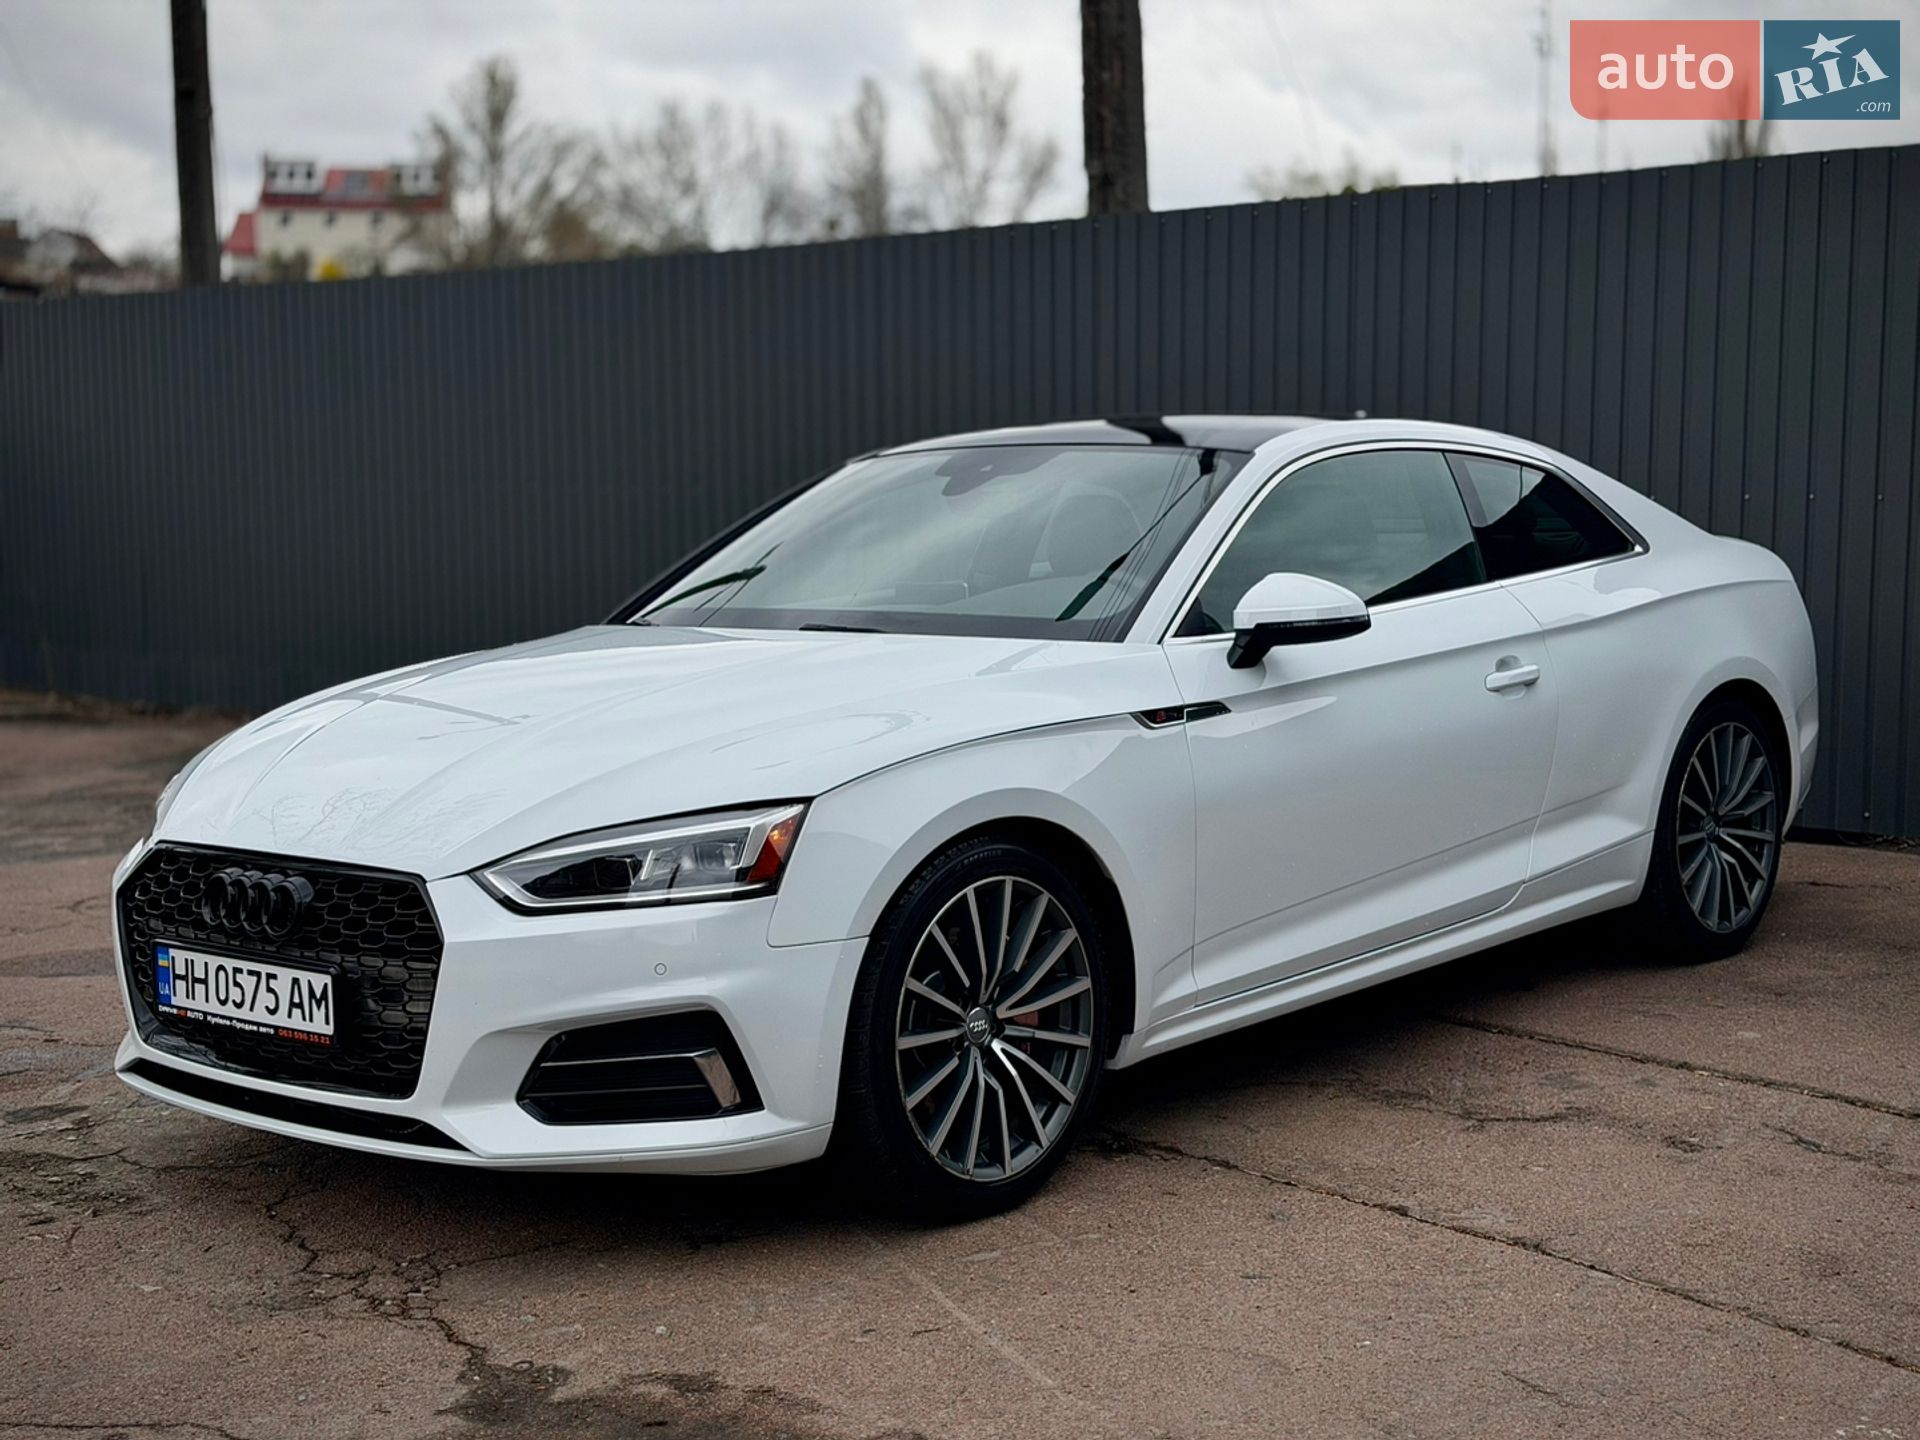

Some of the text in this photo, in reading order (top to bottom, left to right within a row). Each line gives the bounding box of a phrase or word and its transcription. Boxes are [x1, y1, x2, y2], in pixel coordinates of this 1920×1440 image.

[158, 982, 170, 994] UA
[171, 955, 330, 1026] HH 0575 AM
